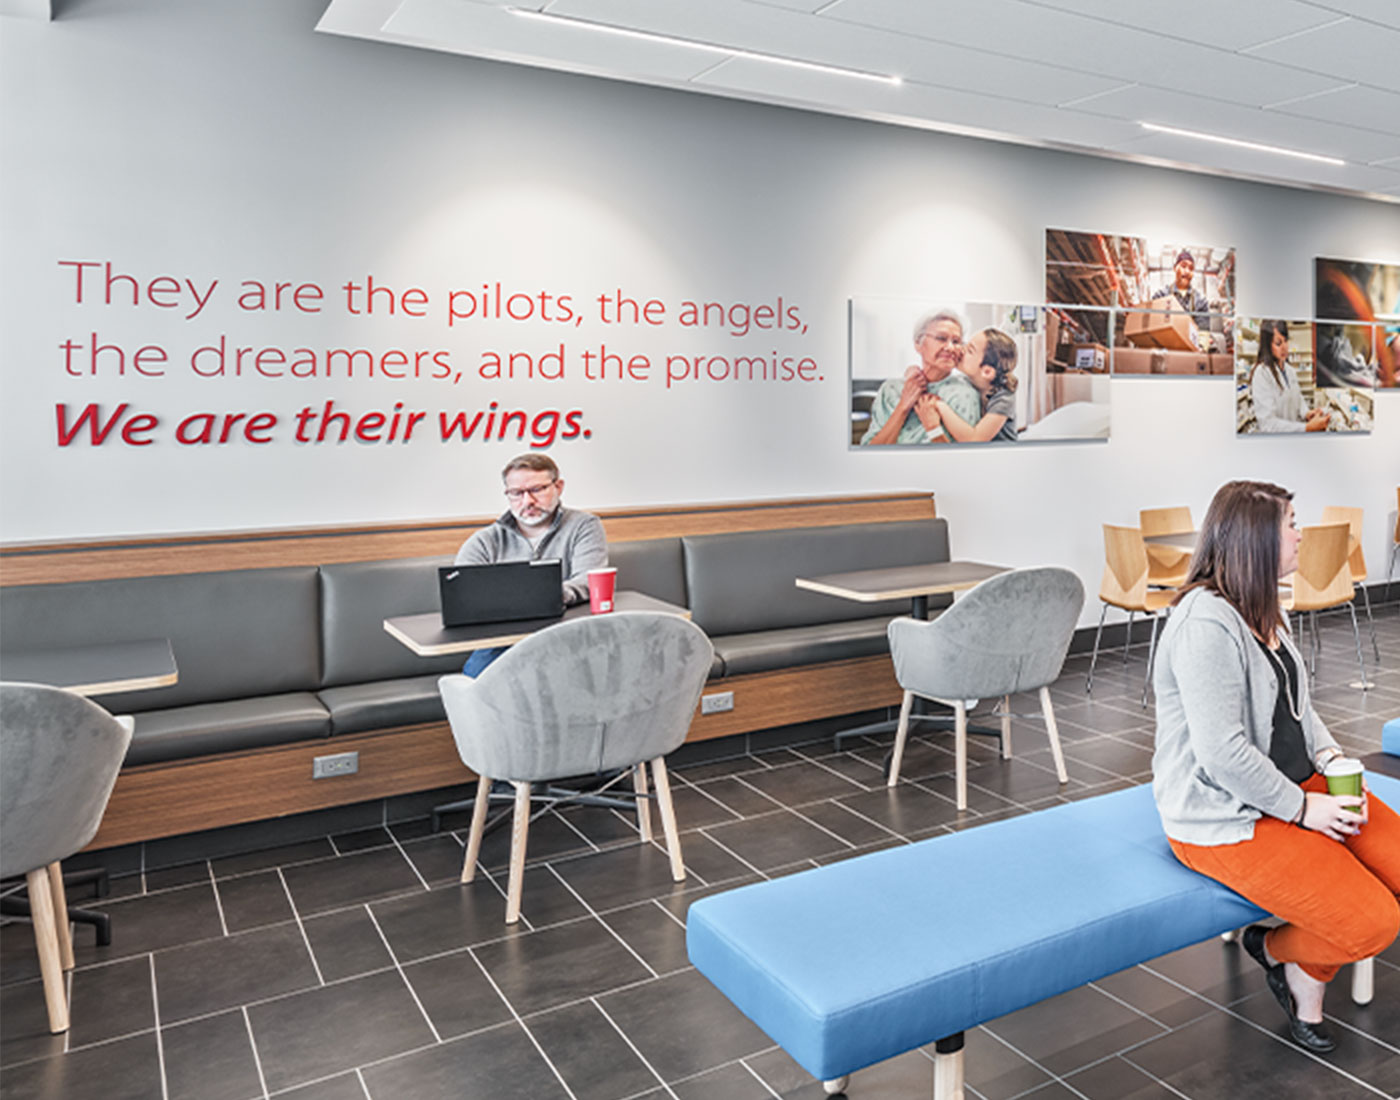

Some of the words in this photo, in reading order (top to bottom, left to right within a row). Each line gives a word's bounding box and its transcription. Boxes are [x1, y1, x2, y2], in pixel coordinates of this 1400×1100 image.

[58, 261, 218, 320] They
[238, 280, 324, 313] are
[342, 275, 430, 317] the
[448, 282, 583, 328] pilots,
[596, 288, 666, 326] the
[678, 297, 809, 337] angels,
[60, 332, 168, 377] the
[191, 335, 463, 385] dreamers,
[477, 344, 565, 381] and
[581, 350, 651, 381] the
[666, 352, 824, 389] promise.
[55, 402, 159, 447] We
[175, 411, 278, 445] are
[295, 399, 427, 444] their
[439, 401, 593, 450] wings.
